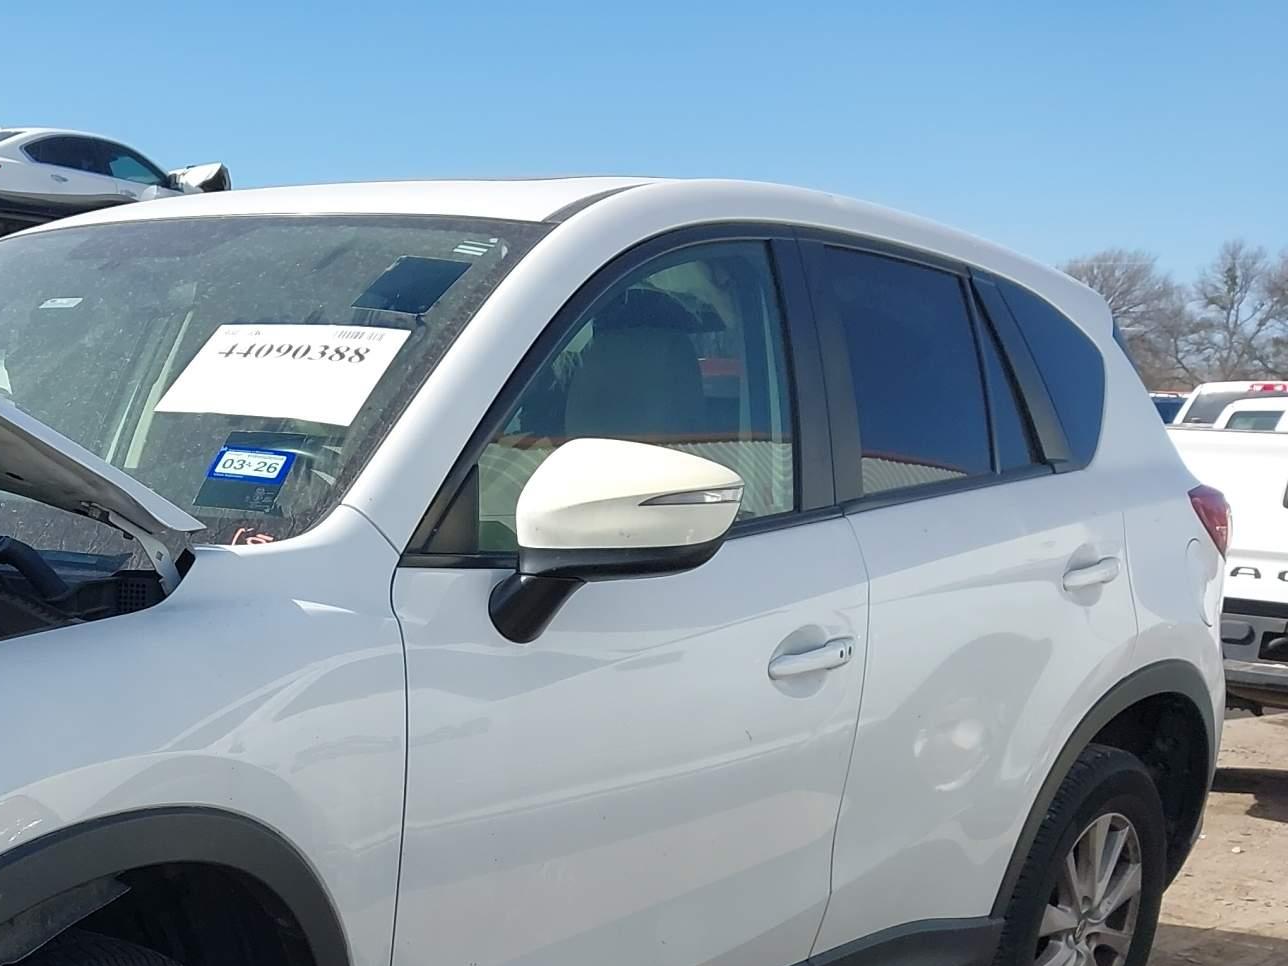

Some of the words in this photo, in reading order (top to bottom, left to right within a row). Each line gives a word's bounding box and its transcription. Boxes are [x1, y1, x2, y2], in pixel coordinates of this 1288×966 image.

[218, 343, 371, 363] 44090388
[221, 458, 246, 471] 03
[254, 461, 280, 474] 26
